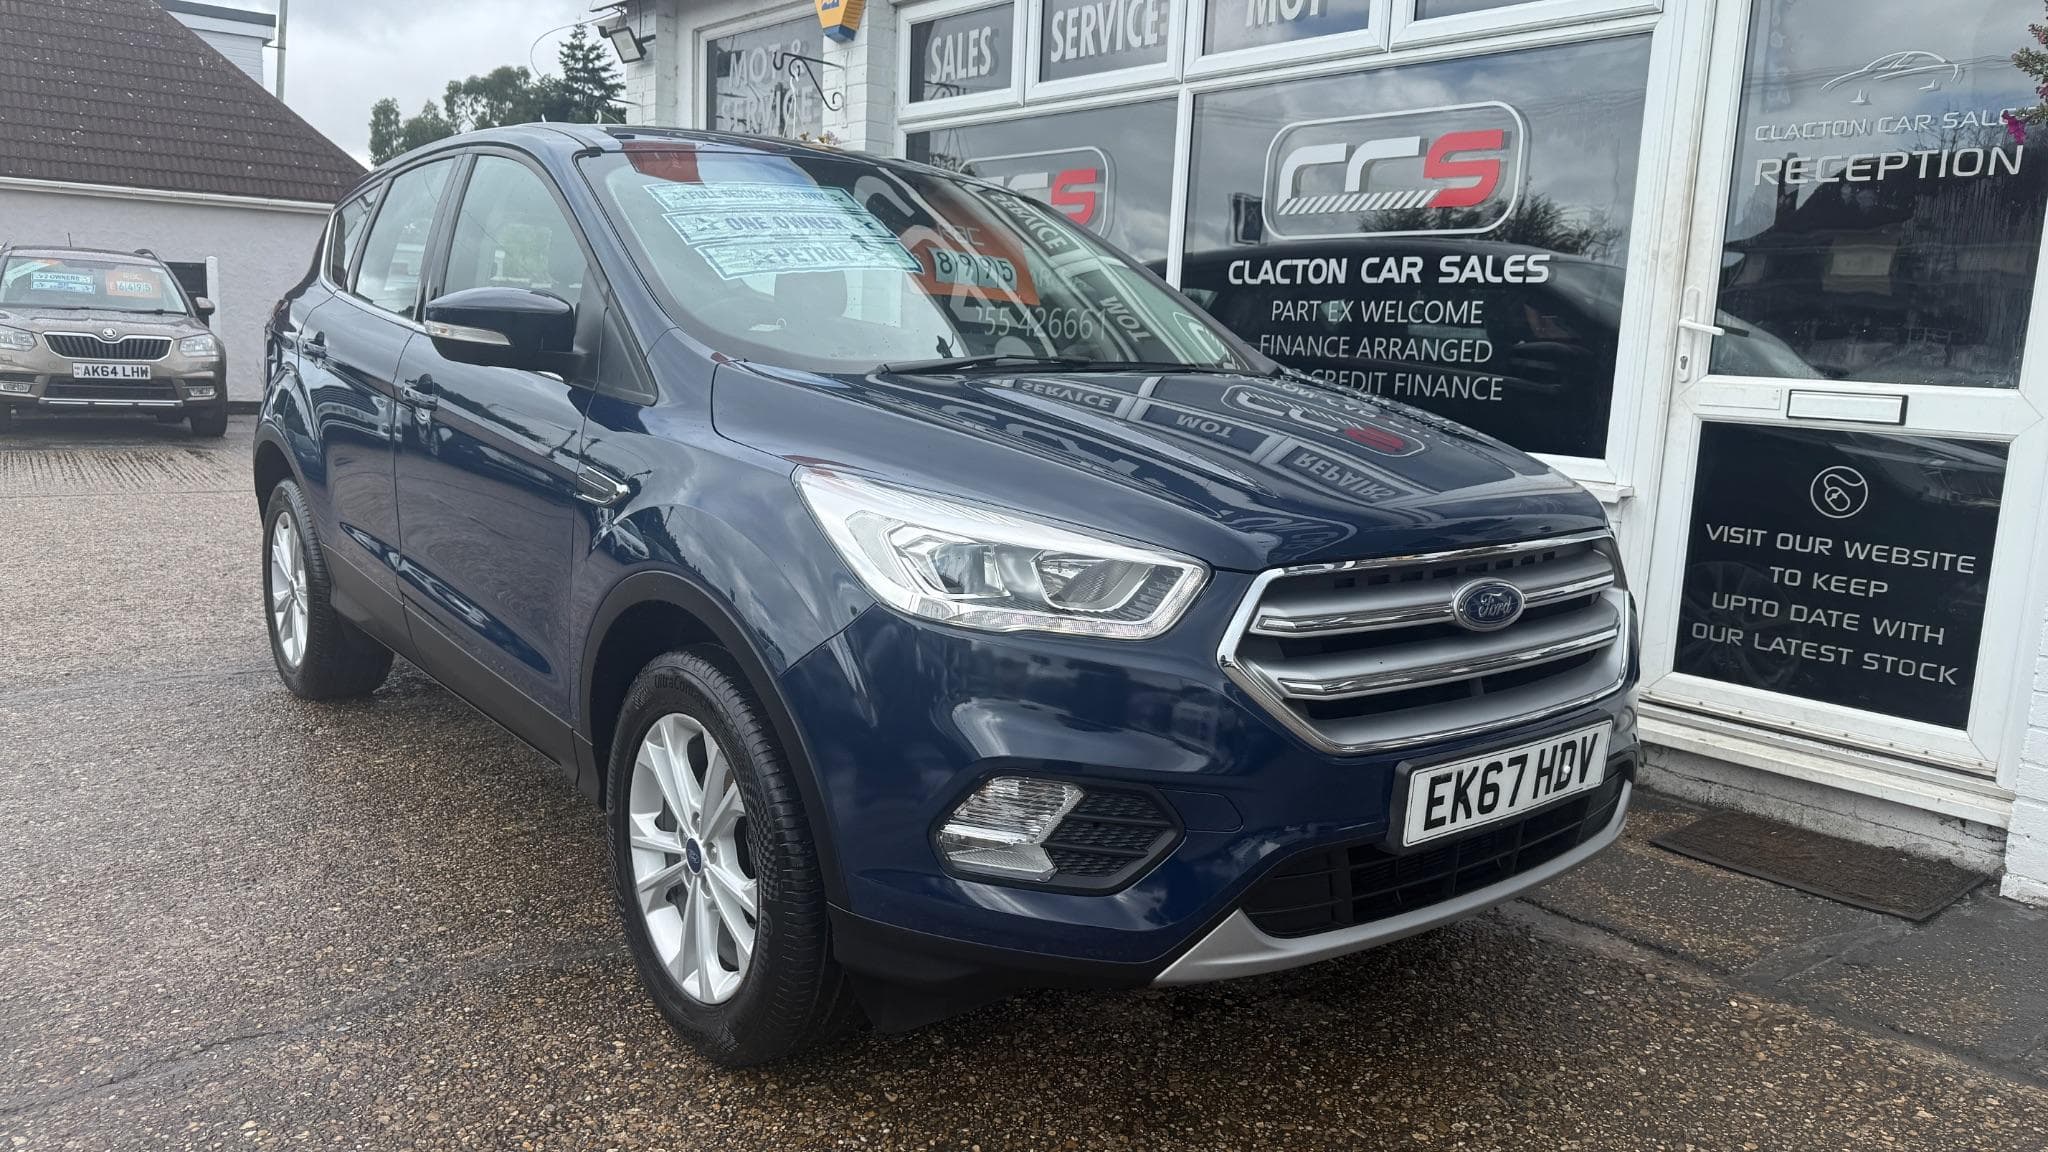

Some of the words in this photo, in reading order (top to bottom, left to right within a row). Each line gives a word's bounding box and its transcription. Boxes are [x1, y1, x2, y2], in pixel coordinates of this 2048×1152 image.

[1051, 0, 1160, 63] SERVICE
[729, 43, 782, 88] MOT
[930, 26, 992, 84] SALES
[1755, 117, 1868, 141] CLACTON
[1878, 114, 1932, 133] CAR
[1942, 107, 2037, 129] SALE
[1754, 145, 2024, 185] RECEPTION
[725, 216, 769, 230] ONE
[772, 216, 848, 231] OWNER
[774, 246, 857, 264] PETROL
[1228, 258, 1348, 285] CLACTON
[1361, 256, 1423, 284] CAR
[1438, 254, 1551, 284] SALES
[1271, 300, 1322, 322] PART
[1328, 300, 1354, 322] EX
[1361, 300, 1484, 324] WELCOME
[1260, 334, 1350, 358] FINANCE
[1356, 337, 1493, 364] ARRANGED
[83, 366, 118, 377] AK64
[123, 366, 149, 378] LHW
[1395, 373, 1503, 401] FINANCE
[1706, 523, 1767, 546] VISIT
[1776, 532, 1833, 556] OUR
[1844, 540, 1976, 574] WEBSITE
[1769, 566, 1801, 587] TO
[1812, 572, 1888, 598] KEEP
[1478, 591, 1513, 618] Ford
[1711, 592, 1779, 618] UPTO
[1790, 604, 1860, 631] DATE
[1872, 617, 1945, 645] WITH
[1691, 622, 1743, 646] OUR
[1754, 632, 1853, 665] LATEST
[1862, 652, 1959, 686] STOCK
[1423, 753, 1529, 832] EK67
[1532, 733, 1598, 800] HDV
